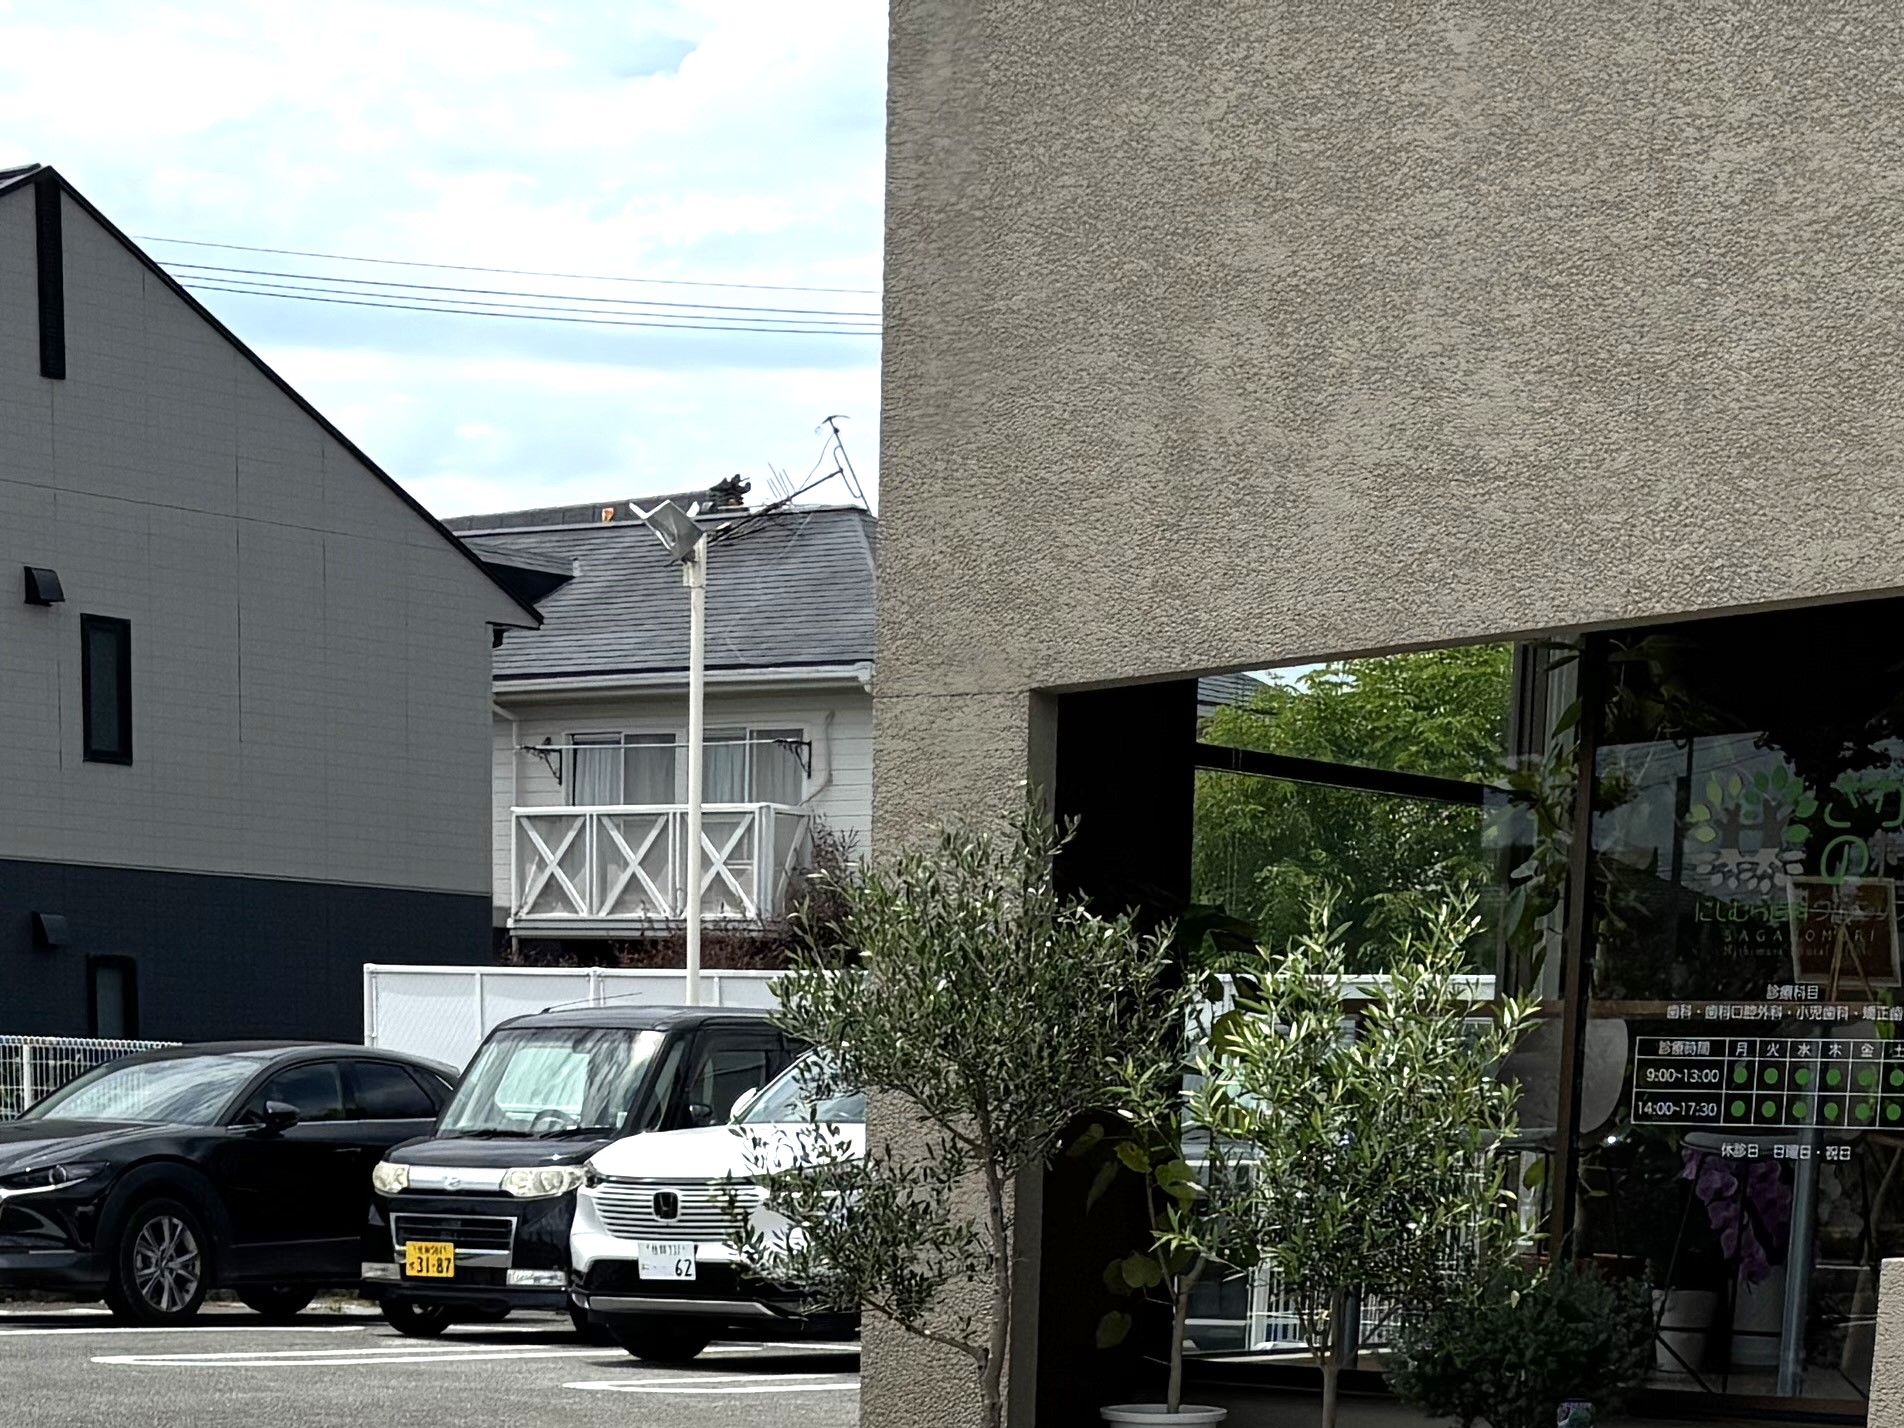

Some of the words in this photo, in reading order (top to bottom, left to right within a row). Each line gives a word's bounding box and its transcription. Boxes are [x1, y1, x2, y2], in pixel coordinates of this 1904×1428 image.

[1724, 927, 1875, 943] SAGAOMRI
[1735, 1041, 1748, 1057] 月
[1766, 1041, 1780, 1057] 火
[1797, 1042, 1811, 1057] 水
[1828, 1043, 1842, 1058] 木
[1860, 1043, 1875, 1058] 金
